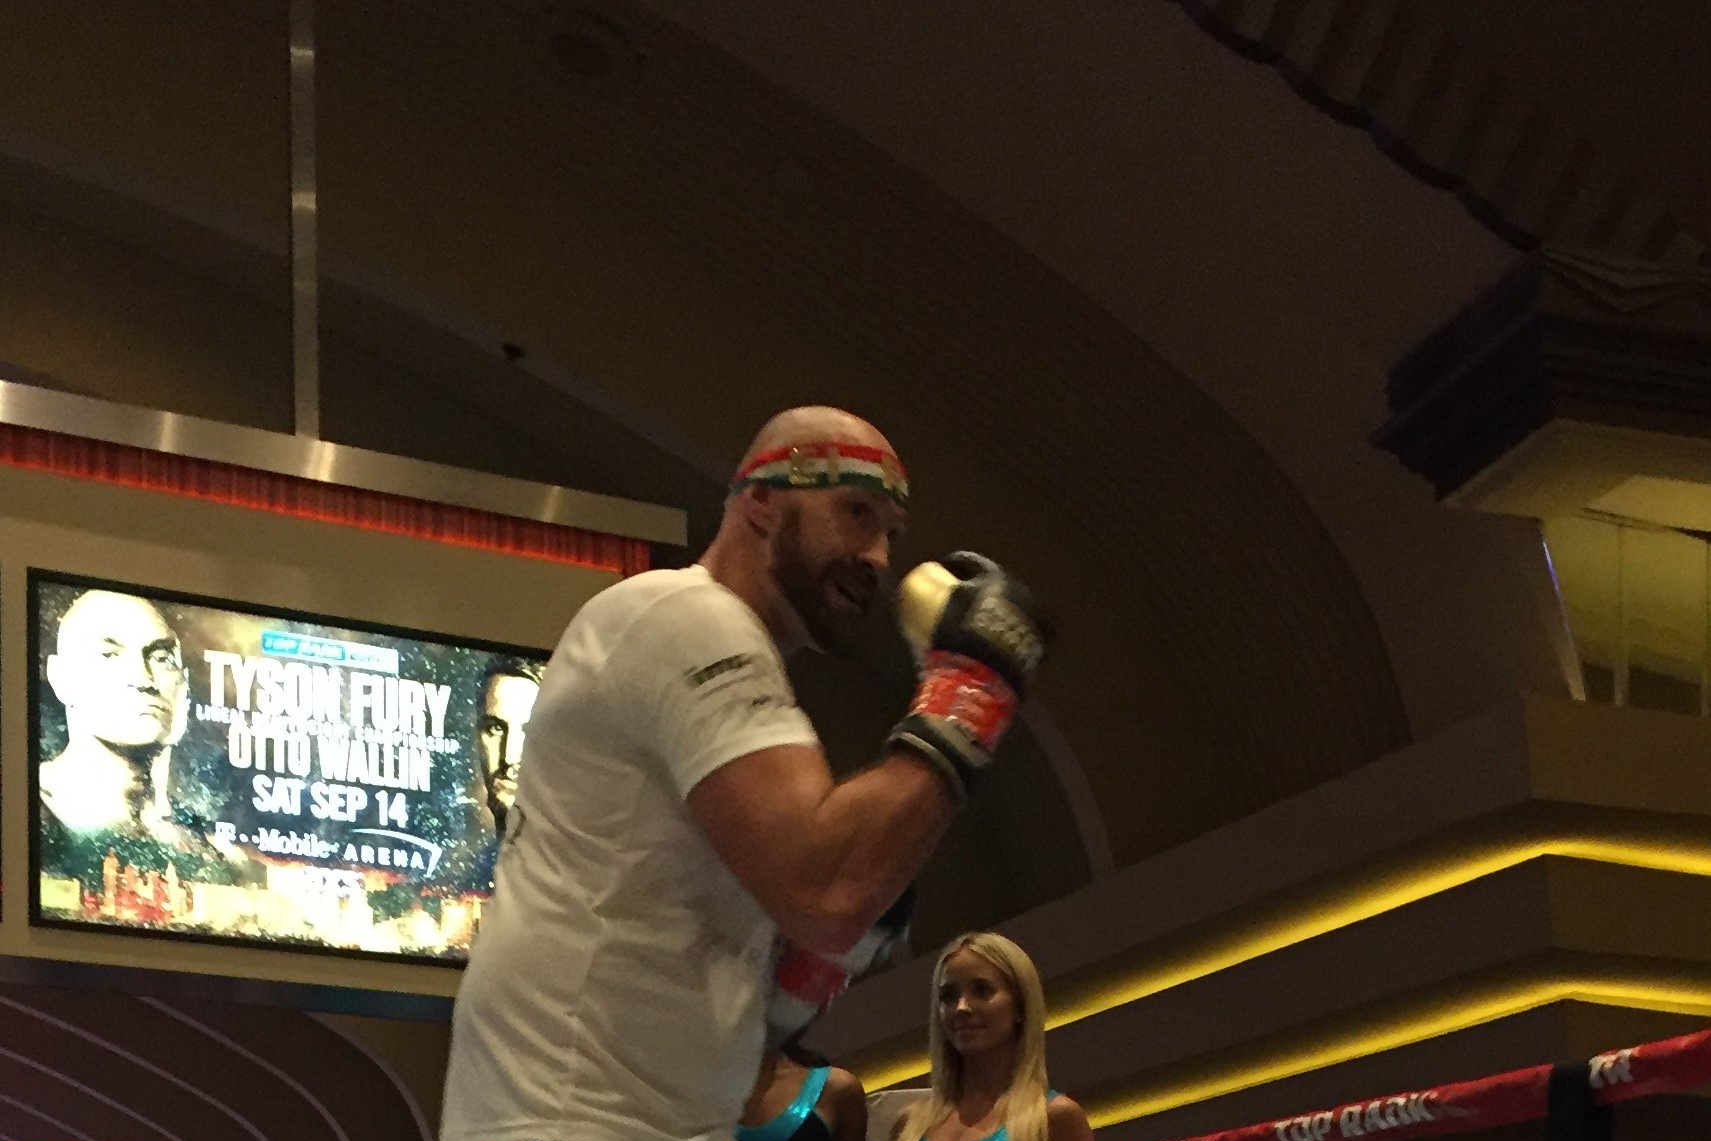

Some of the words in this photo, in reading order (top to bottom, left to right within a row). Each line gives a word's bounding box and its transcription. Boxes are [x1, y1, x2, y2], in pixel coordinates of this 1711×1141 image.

[204, 650, 342, 724] TYSON
[350, 671, 451, 738] FURY
[228, 722, 311, 777] OTTO
[315, 737, 431, 792] WALLIN
[252, 774, 305, 815] SAT
[310, 781, 368, 822] SEP
[375, 789, 409, 828] 14
[343, 843, 424, 870] ARENA
[1340, 1091, 1438, 1138] RANK
